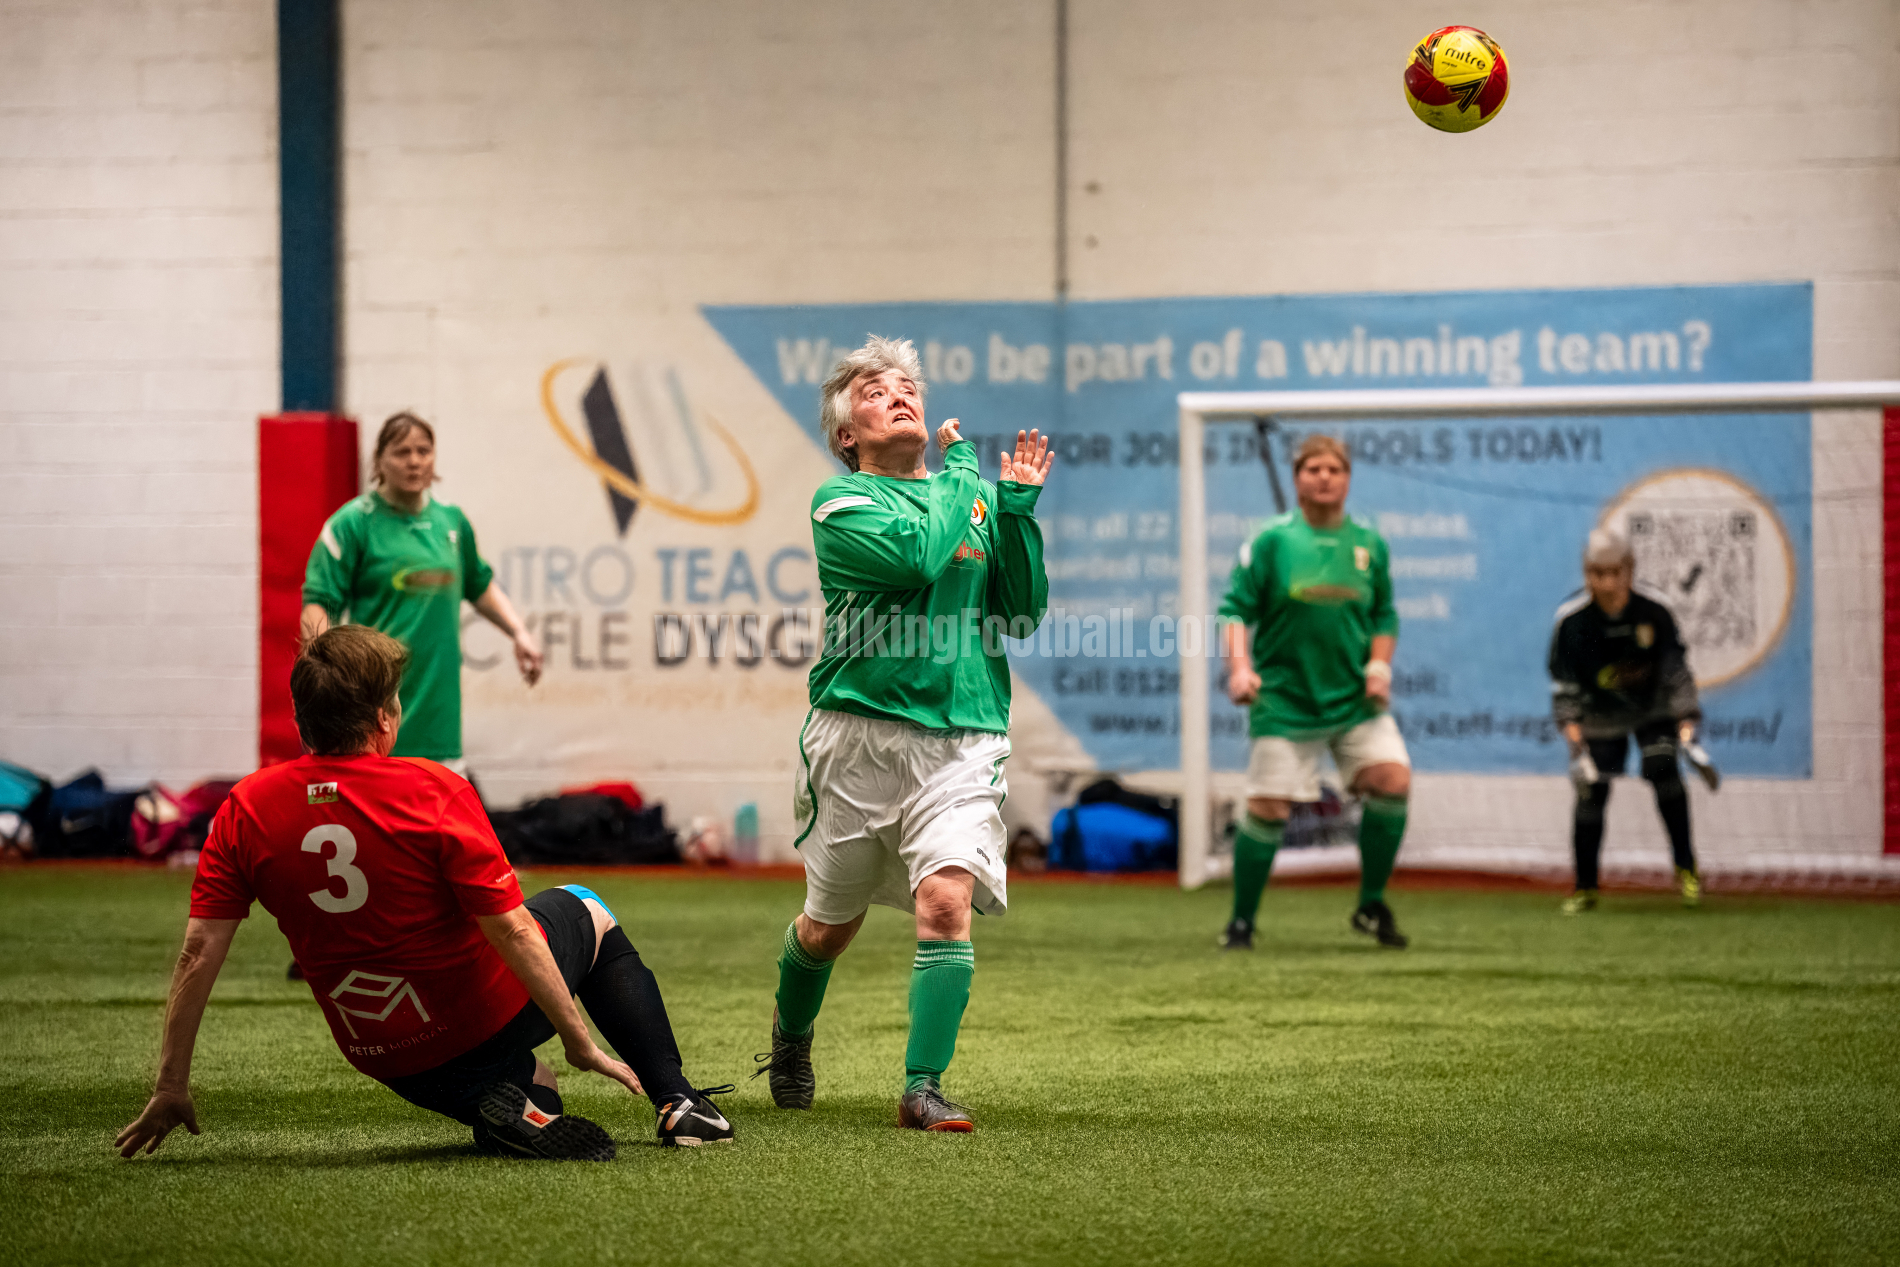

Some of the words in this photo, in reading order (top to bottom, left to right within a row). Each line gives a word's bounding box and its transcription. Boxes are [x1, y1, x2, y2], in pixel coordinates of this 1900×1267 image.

[1444, 47, 1486, 71] mitre
[987, 333, 1052, 384] be
[1065, 336, 1173, 392] part
[1189, 328, 1243, 380] of
[1257, 339, 1288, 379] a
[1303, 324, 1523, 387] winning
[1537, 320, 1713, 374] team?
[1466, 425, 1603, 464] TODAY!
[656, 546, 812, 604] TEAC
[953, 541, 986, 562] gher
[459, 609, 632, 671] CFLE
[654, 612, 817, 668] DYSG
[301, 823, 369, 914] 3
[349, 1044, 386, 1056] PETER
